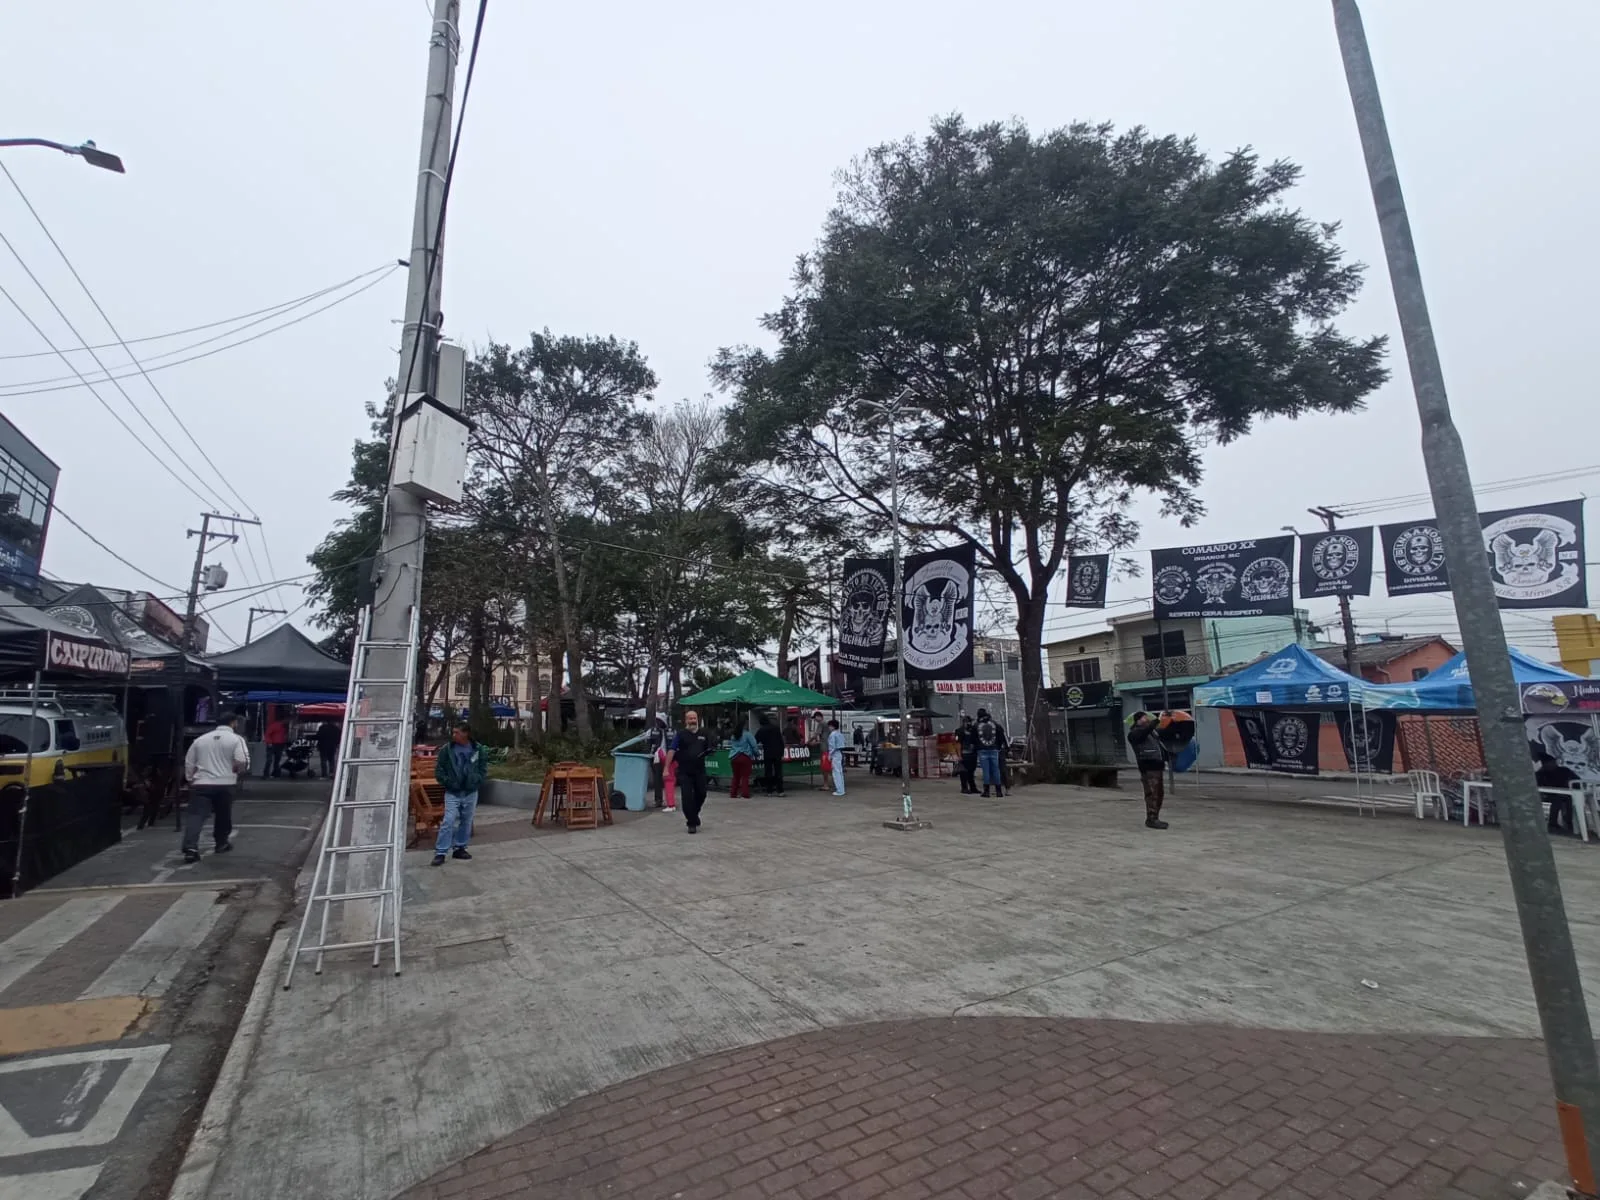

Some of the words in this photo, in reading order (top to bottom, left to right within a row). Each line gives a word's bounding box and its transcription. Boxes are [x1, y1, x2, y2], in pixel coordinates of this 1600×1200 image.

[1181, 543, 1237, 555] COMANDO
[1239, 540, 1257, 551] XX
[1314, 535, 1357, 555] INSANOS
[1315, 560, 1356, 579] BRASIL
[1397, 553, 1446, 575] BRASIL
[1223, 608, 1263, 616] RESPEITO
[936, 682, 954, 692] SAÍDA
[956, 682, 964, 692] DE
[966, 682, 1004, 692] EMERGÊNCIA
[790, 747, 810, 758] GORO
